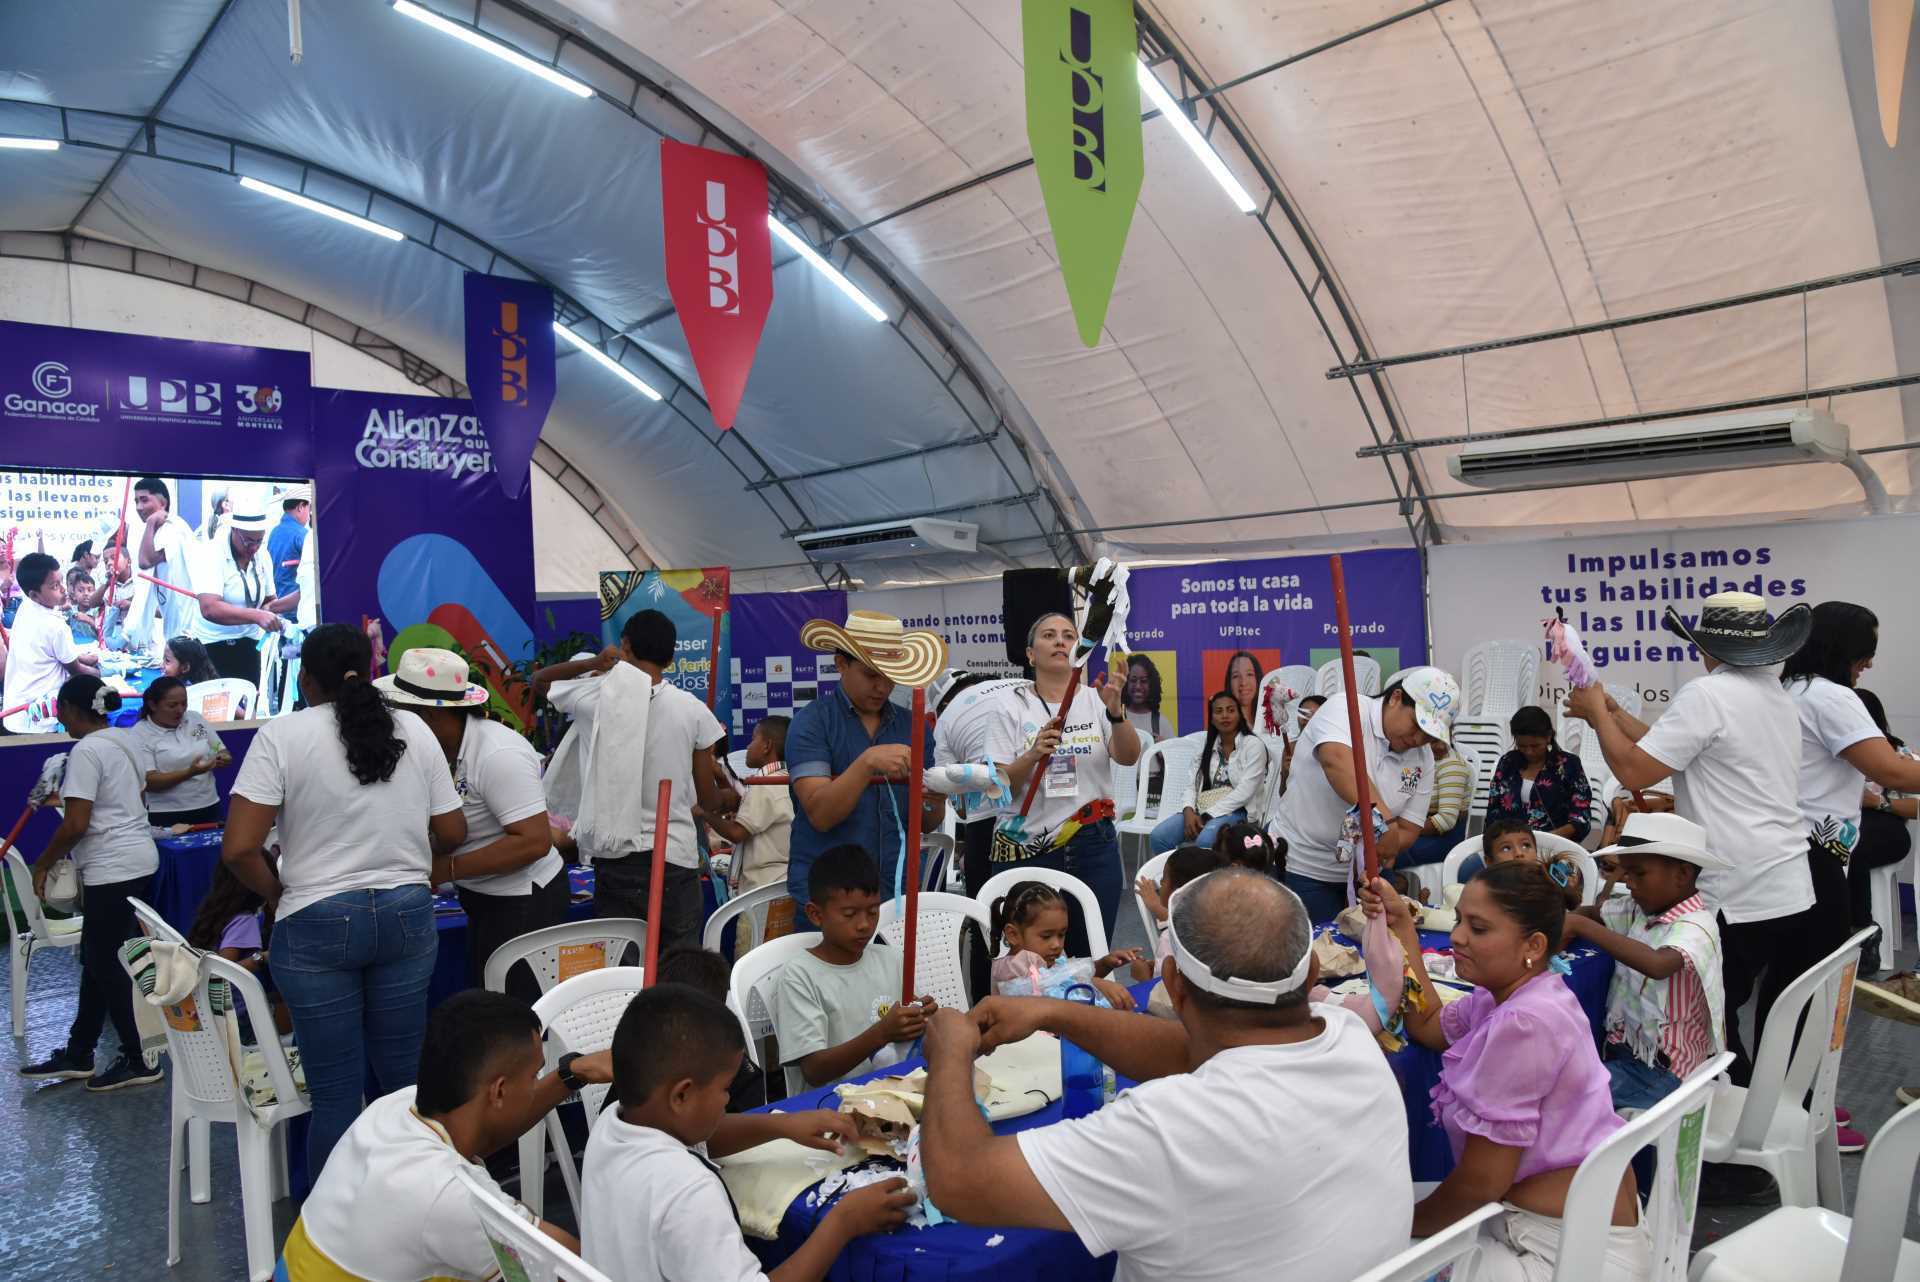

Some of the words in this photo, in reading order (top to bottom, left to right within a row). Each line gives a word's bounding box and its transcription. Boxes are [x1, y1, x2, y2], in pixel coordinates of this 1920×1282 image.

[120, 375, 222, 416] UPB
[4, 393, 99, 417] Ganacor
[20, 472, 113, 487] habilidades
[8, 490, 32, 502] las
[39, 490, 109, 503] llevamos
[0, 506, 79, 521] siguiente
[85, 506, 121, 519] nil
[1567, 547, 1772, 578] Impulsamos
[1181, 577, 1235, 593] Somos
[1239, 576, 1257, 591] tu
[1261, 574, 1300, 589] casa
[1541, 585, 1588, 604] tus
[1599, 574, 1807, 602] habilidades
[1171, 601, 1206, 619] para
[1210, 596, 1249, 614] toda
[1253, 594, 1270, 612] la
[1275, 593, 1314, 611] vida
[1323, 622, 1386, 636] Pogrado
[1580, 610, 1623, 632] las
[955, 630, 967, 643] la
[1219, 625, 1261, 637] UPBtec
[1055, 745, 1092, 755] odos!
